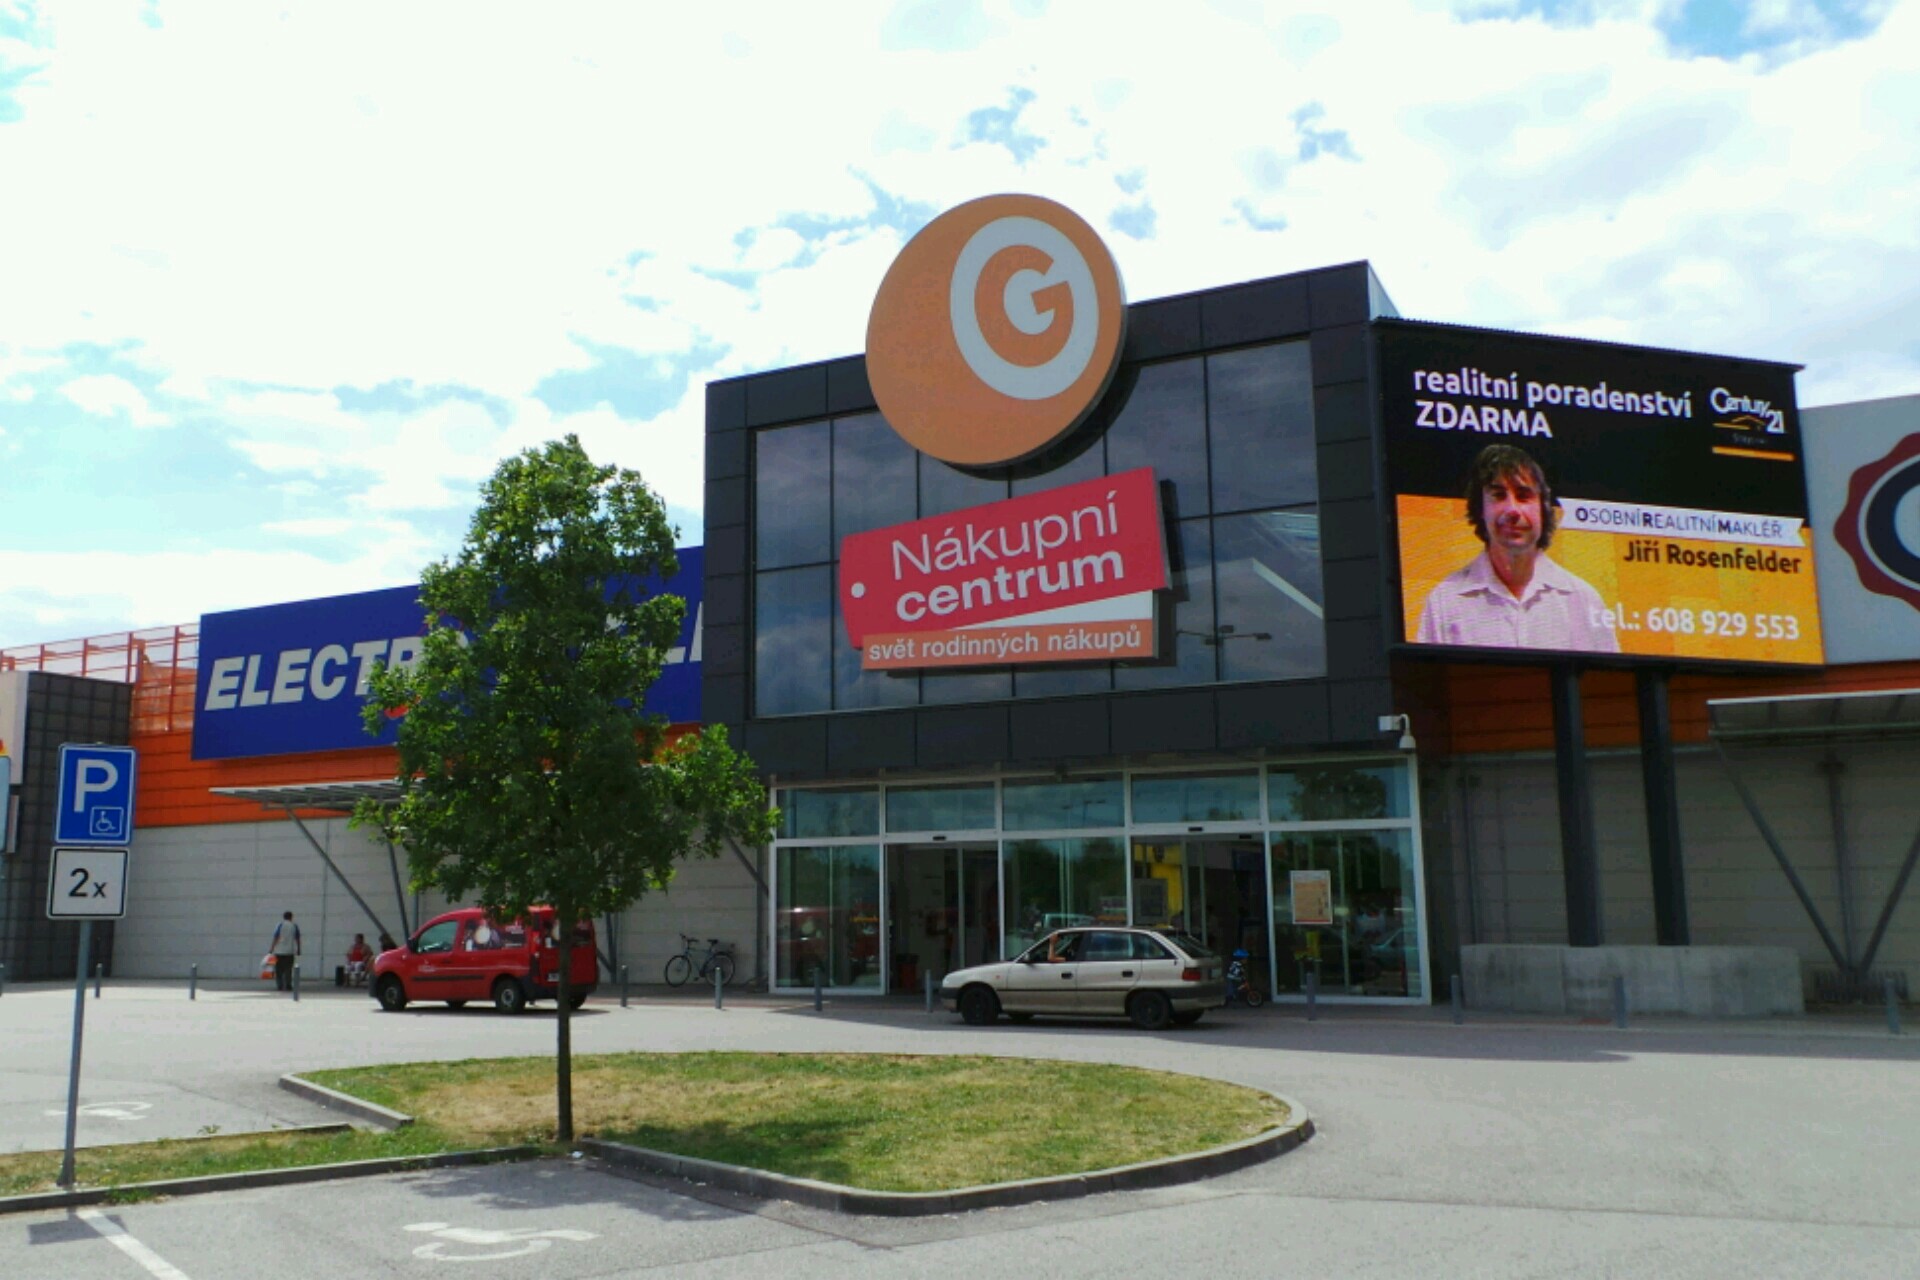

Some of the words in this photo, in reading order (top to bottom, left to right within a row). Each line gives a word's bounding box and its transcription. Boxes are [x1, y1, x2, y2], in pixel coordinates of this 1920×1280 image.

[1413, 367, 1519, 400] realitní
[1526, 381, 1693, 418] poradenství
[1415, 399, 1553, 438] ZDARMA
[1765, 410, 1785, 434] 21
[892, 490, 1119, 581] Nákupní
[1624, 540, 1661, 564] Jiří
[1667, 543, 1802, 574] Rosenfelder
[895, 550, 1126, 622] centrum
[1588, 602, 1641, 632] tel.:
[1647, 607, 1695, 634] 608
[1701, 610, 1747, 637] 929
[1754, 612, 1800, 640] 553
[868, 637, 915, 661] svět
[921, 630, 1039, 659] rodinných
[1048, 623, 1142, 652] nákupů
[203, 630, 469, 711] ELECTR
[73, 758, 119, 814] P
[68, 867, 107, 899] 2x
